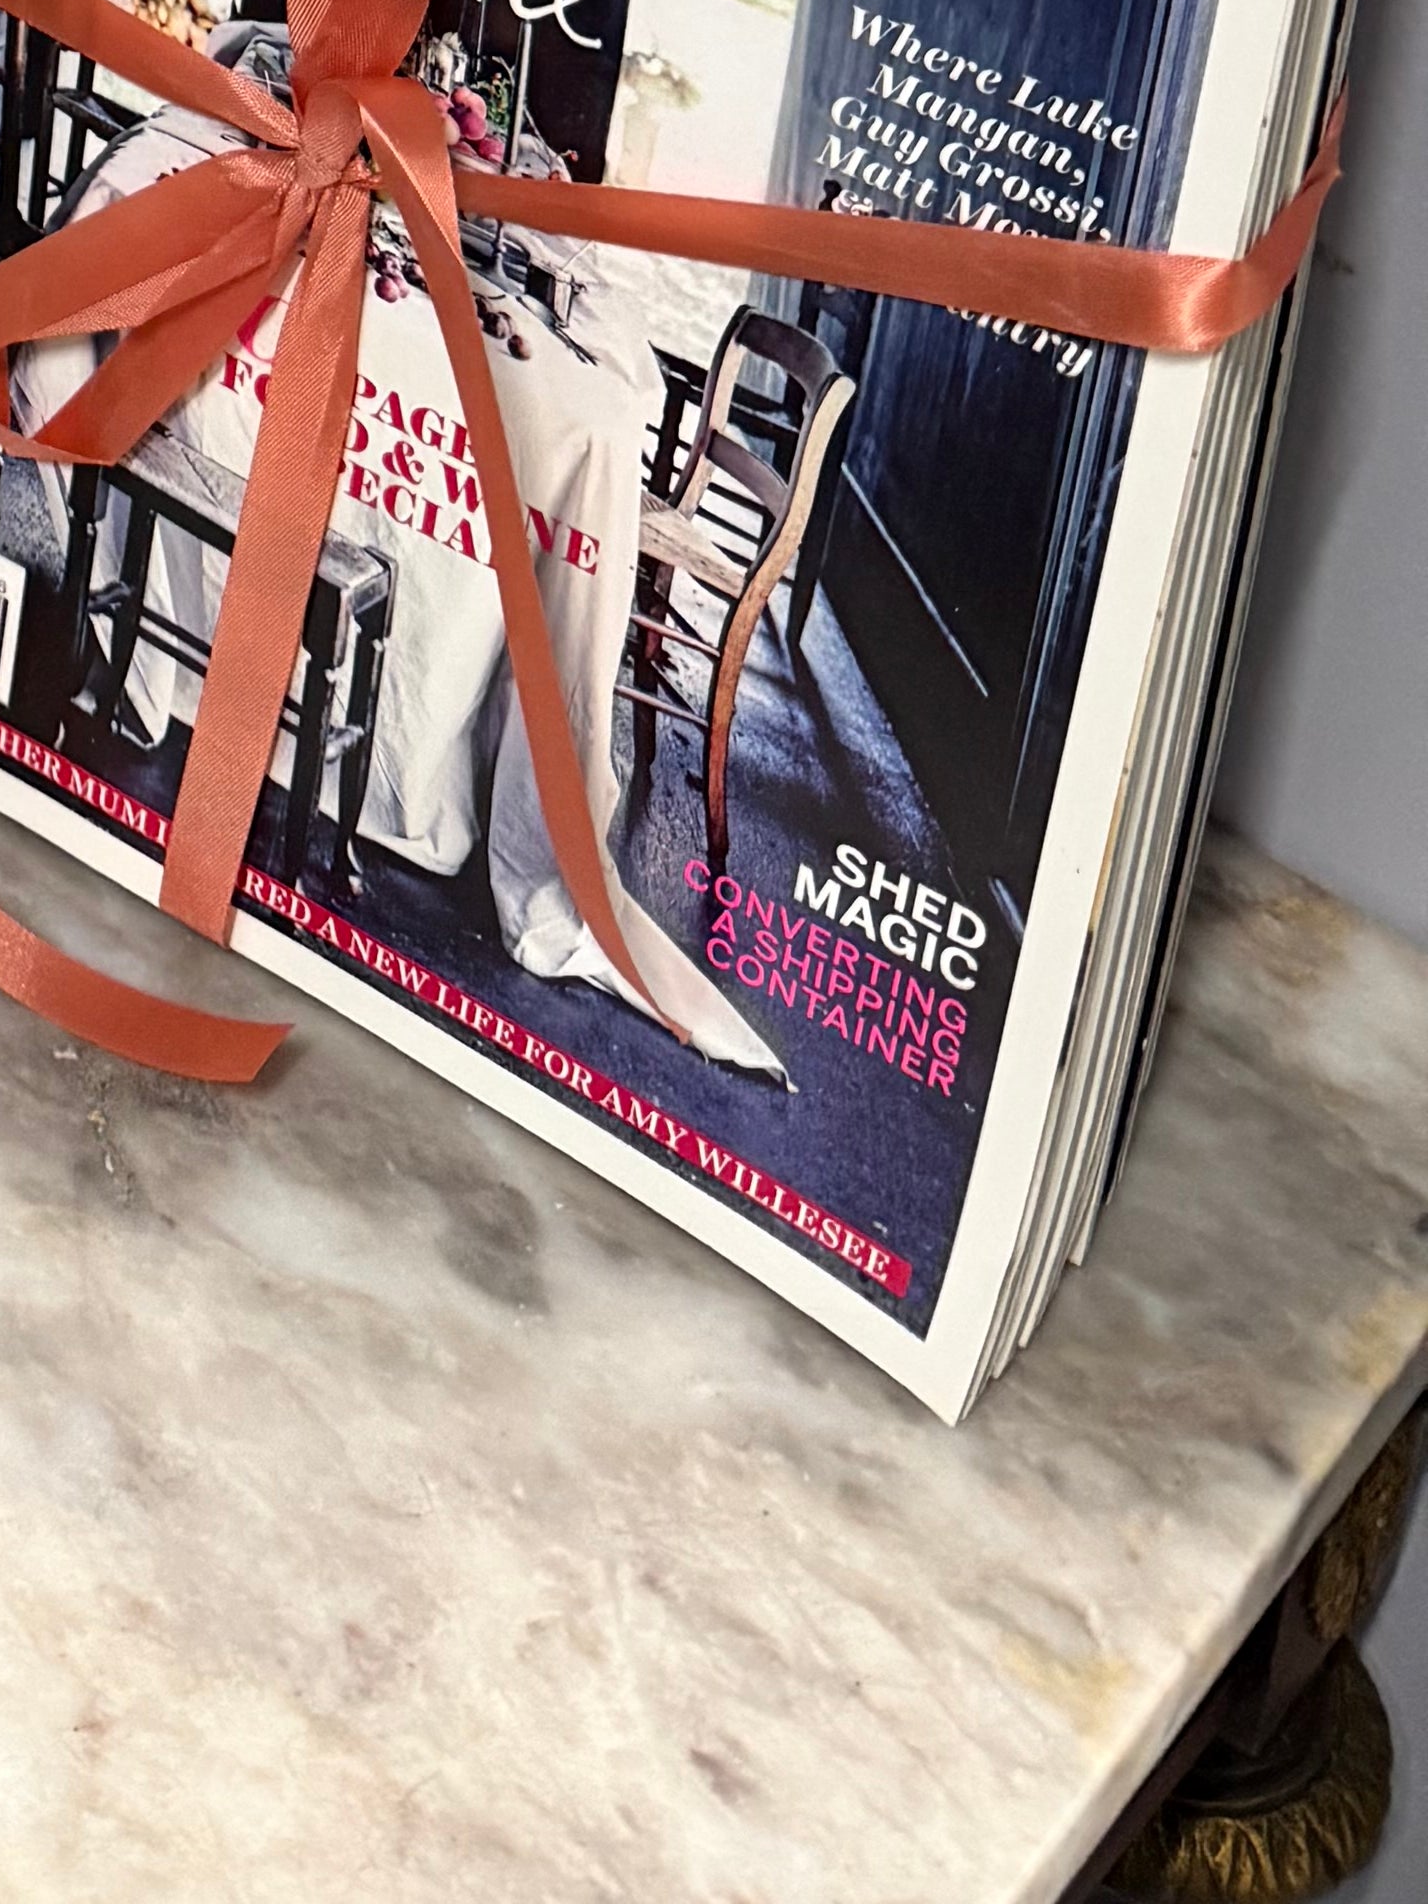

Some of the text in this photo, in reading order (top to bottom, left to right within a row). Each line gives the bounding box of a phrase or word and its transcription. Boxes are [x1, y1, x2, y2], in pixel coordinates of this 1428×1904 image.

[849, 4, 1140, 152] Where Luke
[865, 63, 1087, 188] Mangan,
[815, 134, 940, 209] Matt
[830, 94, 932, 167] Guy
[937, 145, 1114, 245] Grossi,
[381, 439, 425, 486] &
[439, 459, 601, 577] WNE
[683, 859, 968, 1035] CONVERTING
[793, 863, 980, 992] MAGIC
[834, 843, 987, 950] SHED
[69, 770, 155, 839] MUM
[318, 916, 340, 947] A
[347, 935, 431, 994] NEW
[435, 982, 515, 1054] LIFE
[522, 1034, 596, 1102] FOR
[597, 1086, 690, 1158] AMY
[694, 1138, 892, 1286] WILLESEE
[705, 937, 955, 1098] CONTAINER
[711, 909, 962, 1069] A SHIPPING
